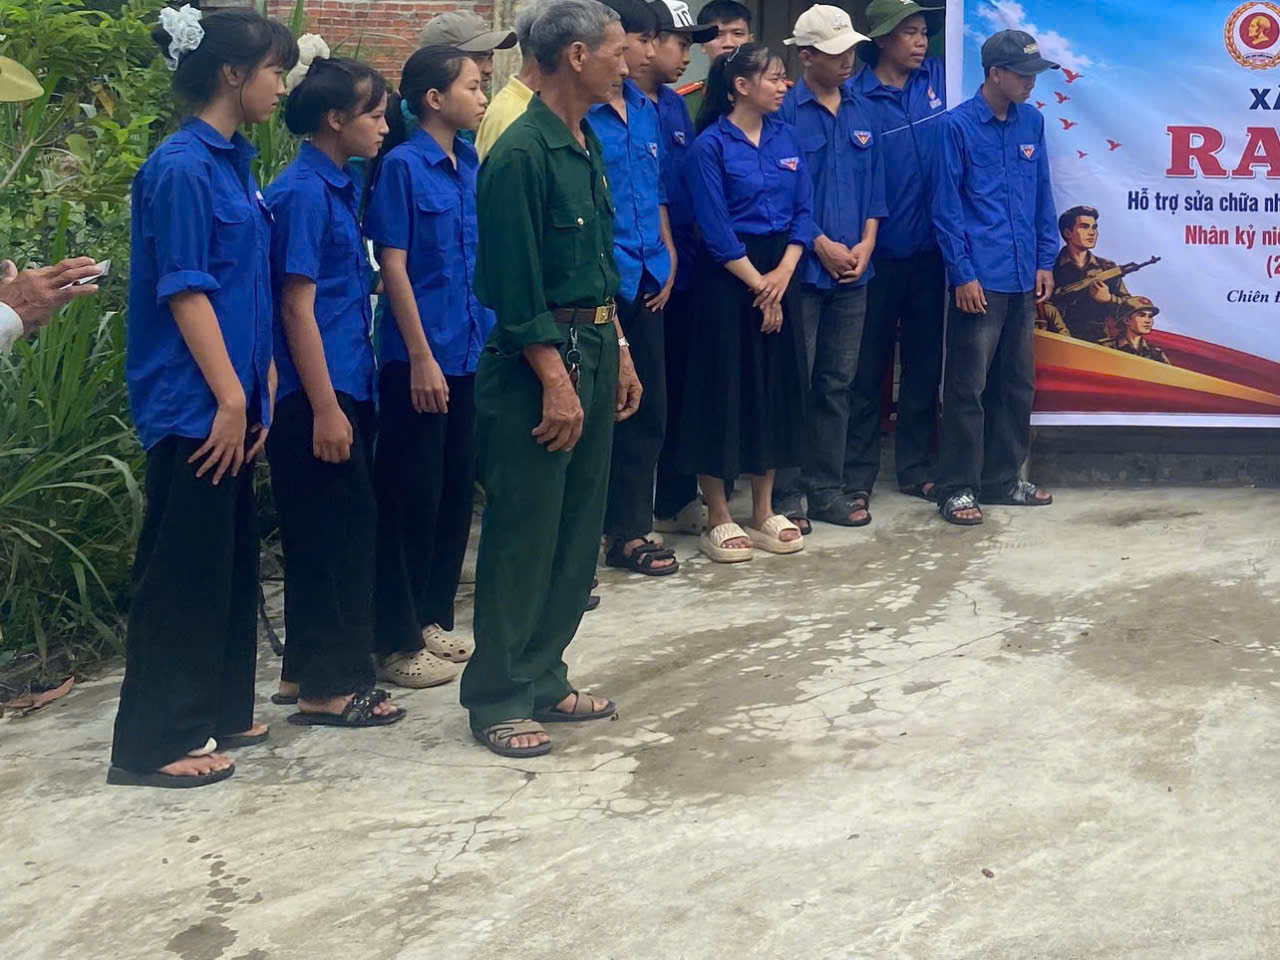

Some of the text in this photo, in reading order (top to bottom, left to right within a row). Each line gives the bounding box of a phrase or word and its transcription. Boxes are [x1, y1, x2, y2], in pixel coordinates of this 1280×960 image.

[1127, 188, 1149, 211] Hỗ
[1155, 191, 1179, 215] trợ
[1184, 190, 1214, 212] sửa
[1219, 191, 1259, 213] chữa
[1185, 225, 1229, 245] Nhân
[1235, 225, 1256, 250] kỷ
[1226, 290, 1269, 304] Chiên
